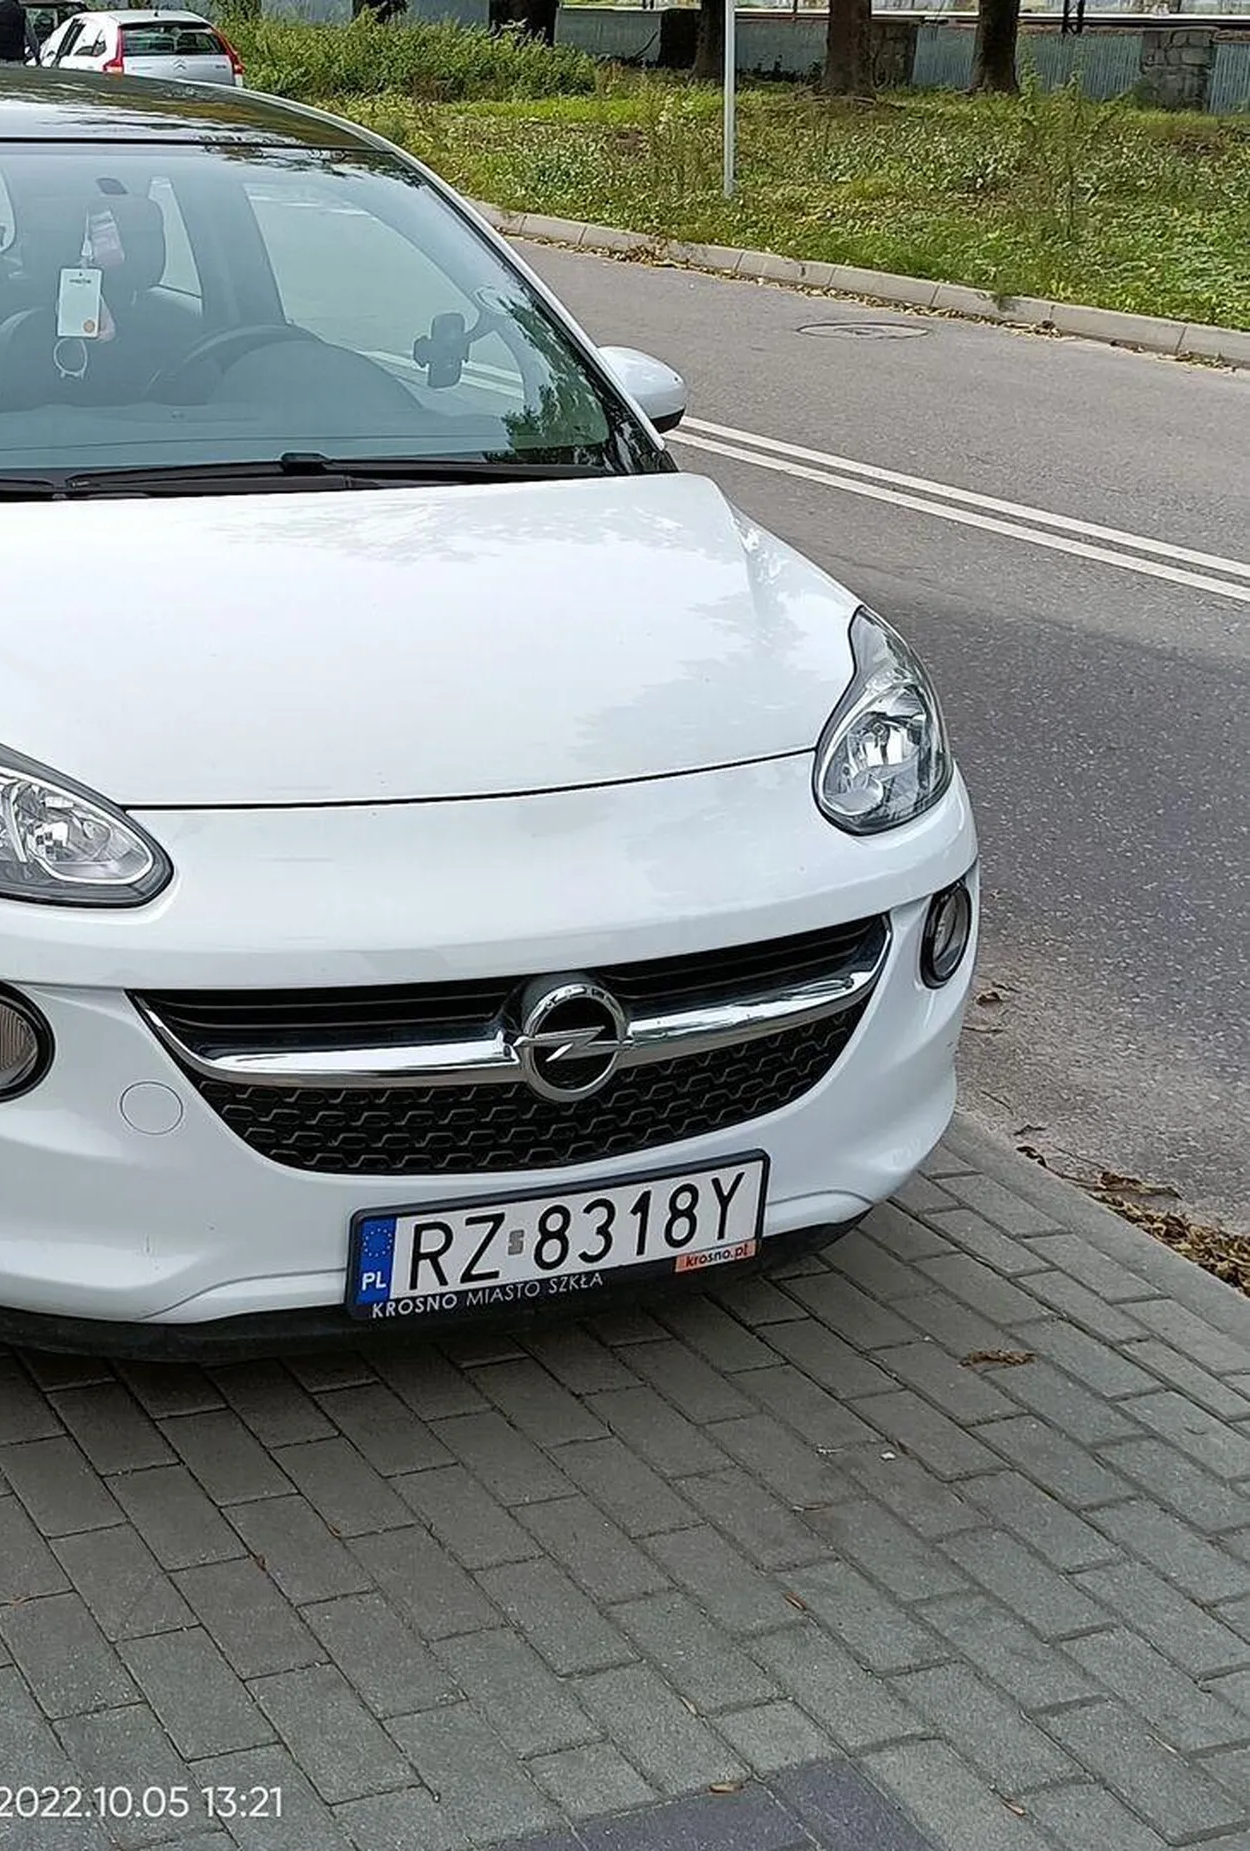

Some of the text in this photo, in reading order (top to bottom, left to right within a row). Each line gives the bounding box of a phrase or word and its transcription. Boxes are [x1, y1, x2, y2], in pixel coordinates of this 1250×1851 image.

[408, 1171, 746, 1291] RZ 8318Y
[685, 1242, 749, 1268] krosno.pl
[361, 1270, 387, 1291] PL
[371, 1272, 603, 1319] KROSNO MIASTO SZKŁA
